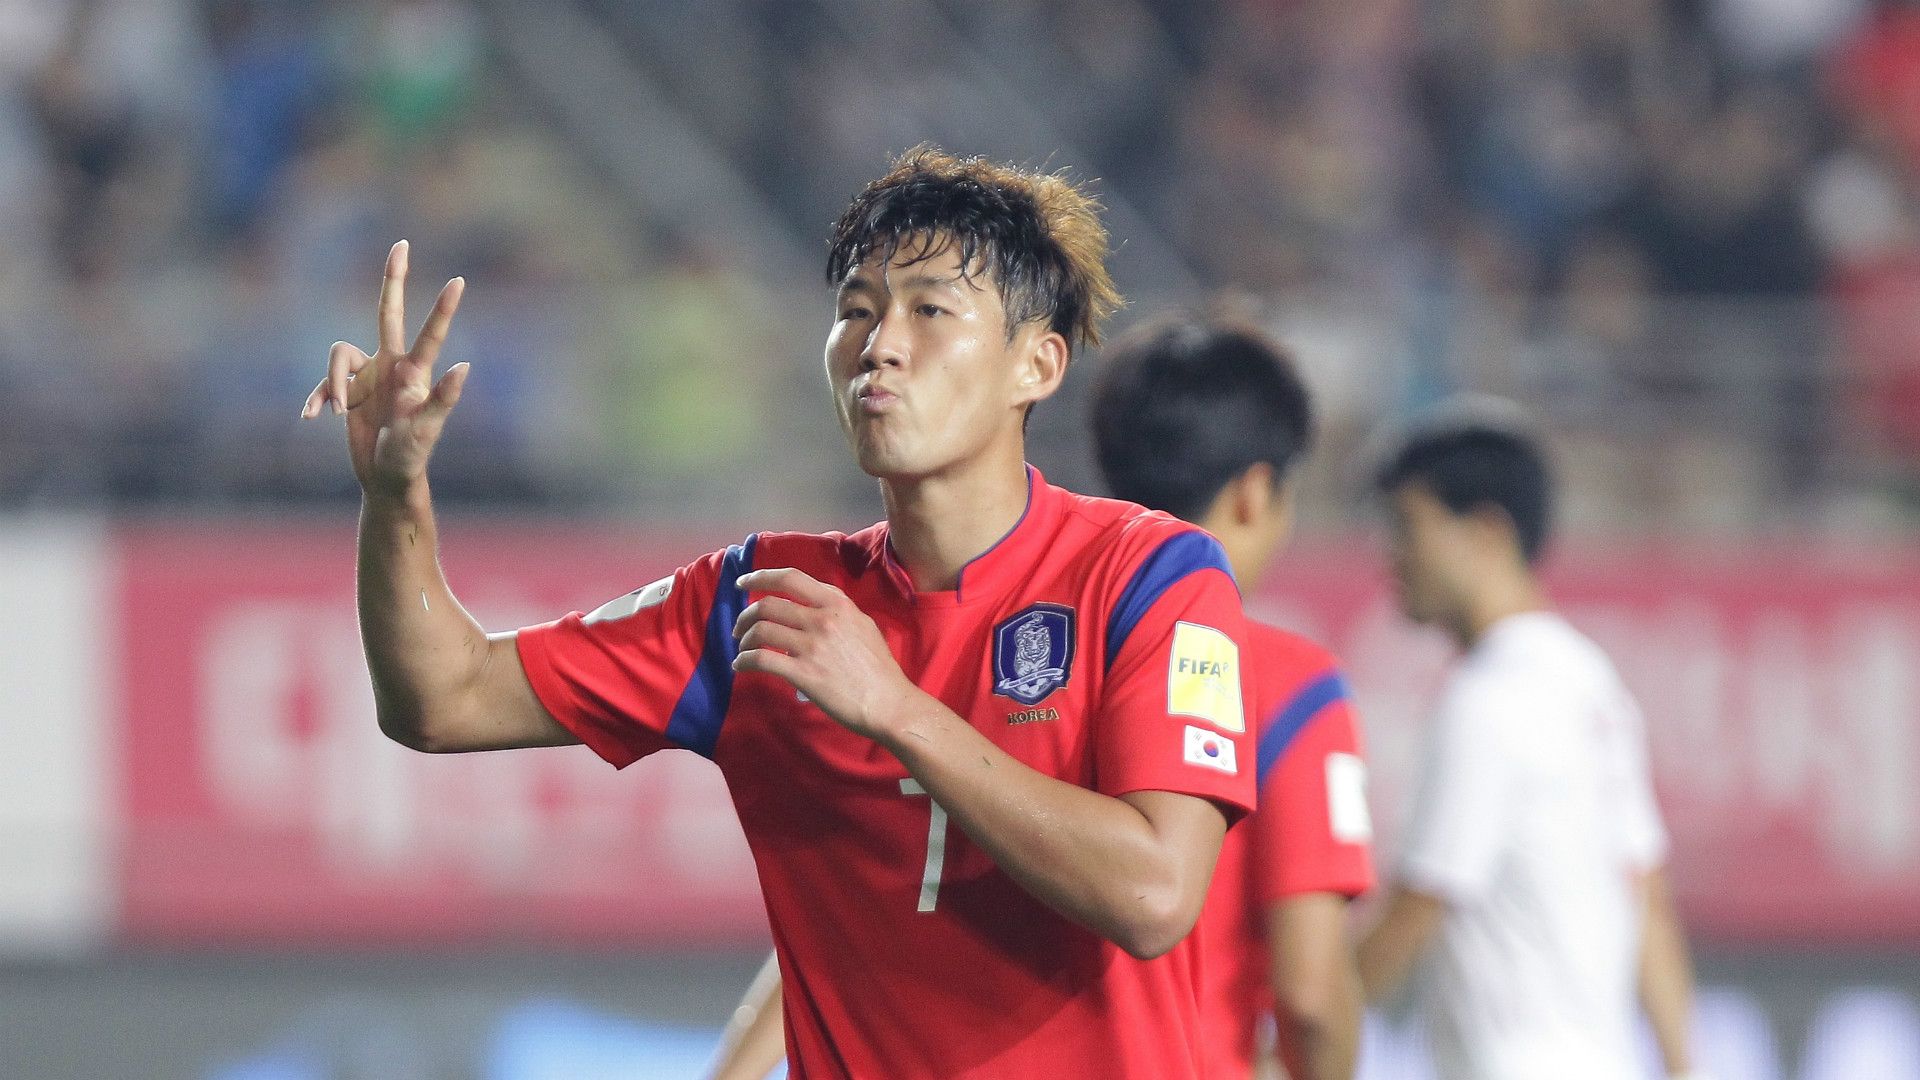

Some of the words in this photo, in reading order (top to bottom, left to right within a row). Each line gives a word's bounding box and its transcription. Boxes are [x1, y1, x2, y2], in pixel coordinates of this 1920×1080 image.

[1178, 657, 1221, 677] FIFA
[1007, 707, 1060, 725] KOREA
[900, 778, 948, 912] 7
